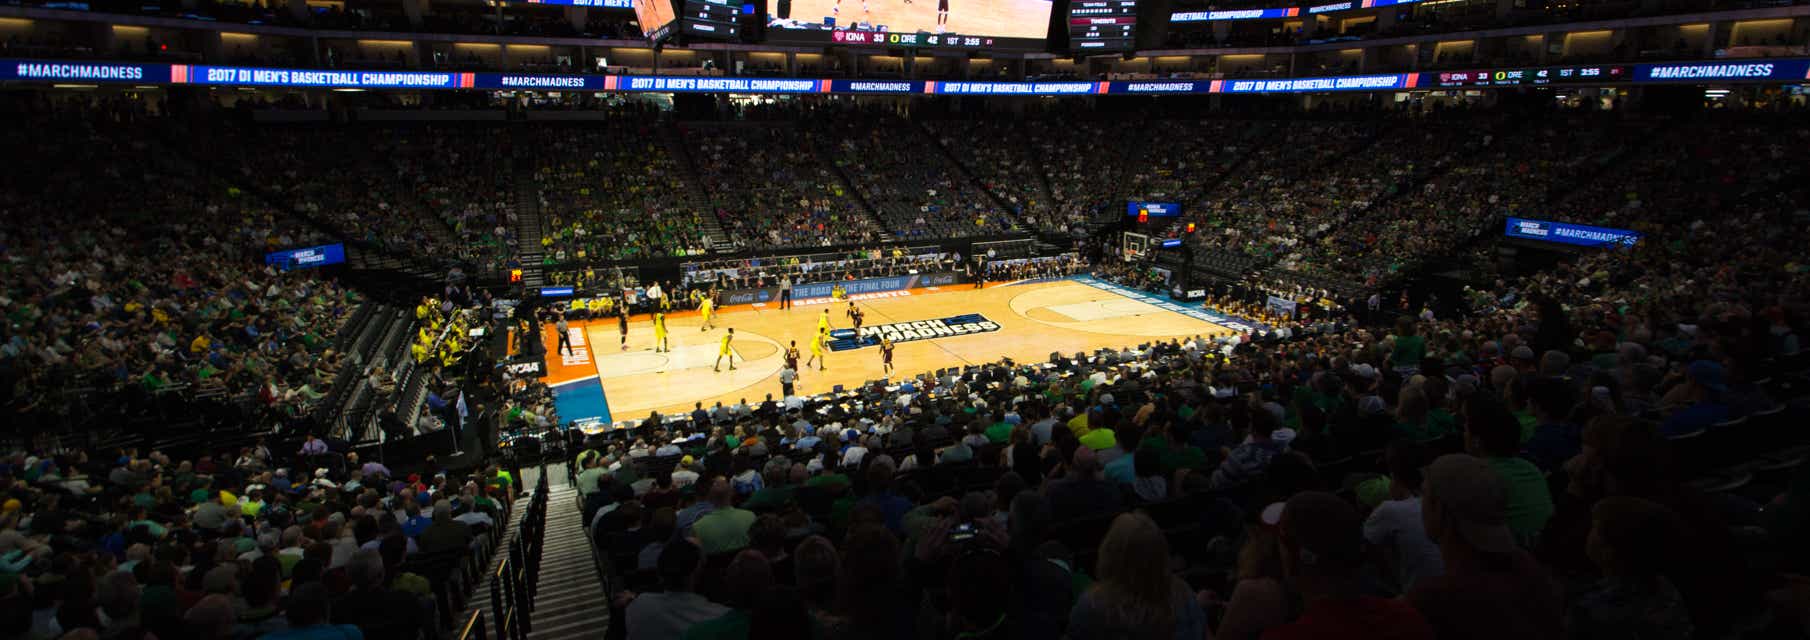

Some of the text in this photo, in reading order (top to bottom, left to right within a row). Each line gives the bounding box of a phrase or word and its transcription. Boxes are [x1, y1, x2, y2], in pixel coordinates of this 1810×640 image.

[1209, 9, 1264, 20] CHAMPIONSHIP
[846, 32, 865, 42] IONA
[874, 34, 885, 42] 33
[901, 35, 917, 44] ORE
[927, 36, 938, 44] 42
[964, 38, 980, 46] 3:55
[17, 63, 142, 79] #MARCHMADNESS
[1507, 71, 1523, 79] ORE
[1537, 70, 1548, 78] 42
[1560, 69, 1573, 77] 1ST
[1650, 64, 1774, 78] #MARCHMADNESS
[208, 69, 449, 86] 2017 DI MEN'S BASKETBALL CHAMPIONSHIP
[1451, 73, 1468, 81] IONA
[502, 77, 585, 88] #MARCHMADNESS
[632, 78, 813, 91] 2017 DI MEN'S BASKETBALL CHAMPIONSHIP
[851, 82, 911, 91] #MARCHMADNESS
[1128, 83, 1194, 91] #MARCHMADNESS
[1233, 76, 1398, 91] 2017 DI MEN'S BASKETBALL CHAMPIONSHIP
[944, 83, 961, 92] 2017
[970, 83, 992, 92] MEN'S
[992, 83, 1033, 93] BASKETBALL
[1034, 83, 1092, 93] CHAMPIONSHIP
[1519, 221, 1541, 231] MARCH
[794, 287, 808, 297] THE
[811, 285, 831, 296] ROAD
[846, 282, 859, 292] THE
[861, 280, 879, 291] FINAL
[881, 278, 900, 289] FOUR
[1187, 289, 1206, 298] NCAA
[860, 318, 947, 337] MARCH
[881, 321, 997, 343] MADNESS
